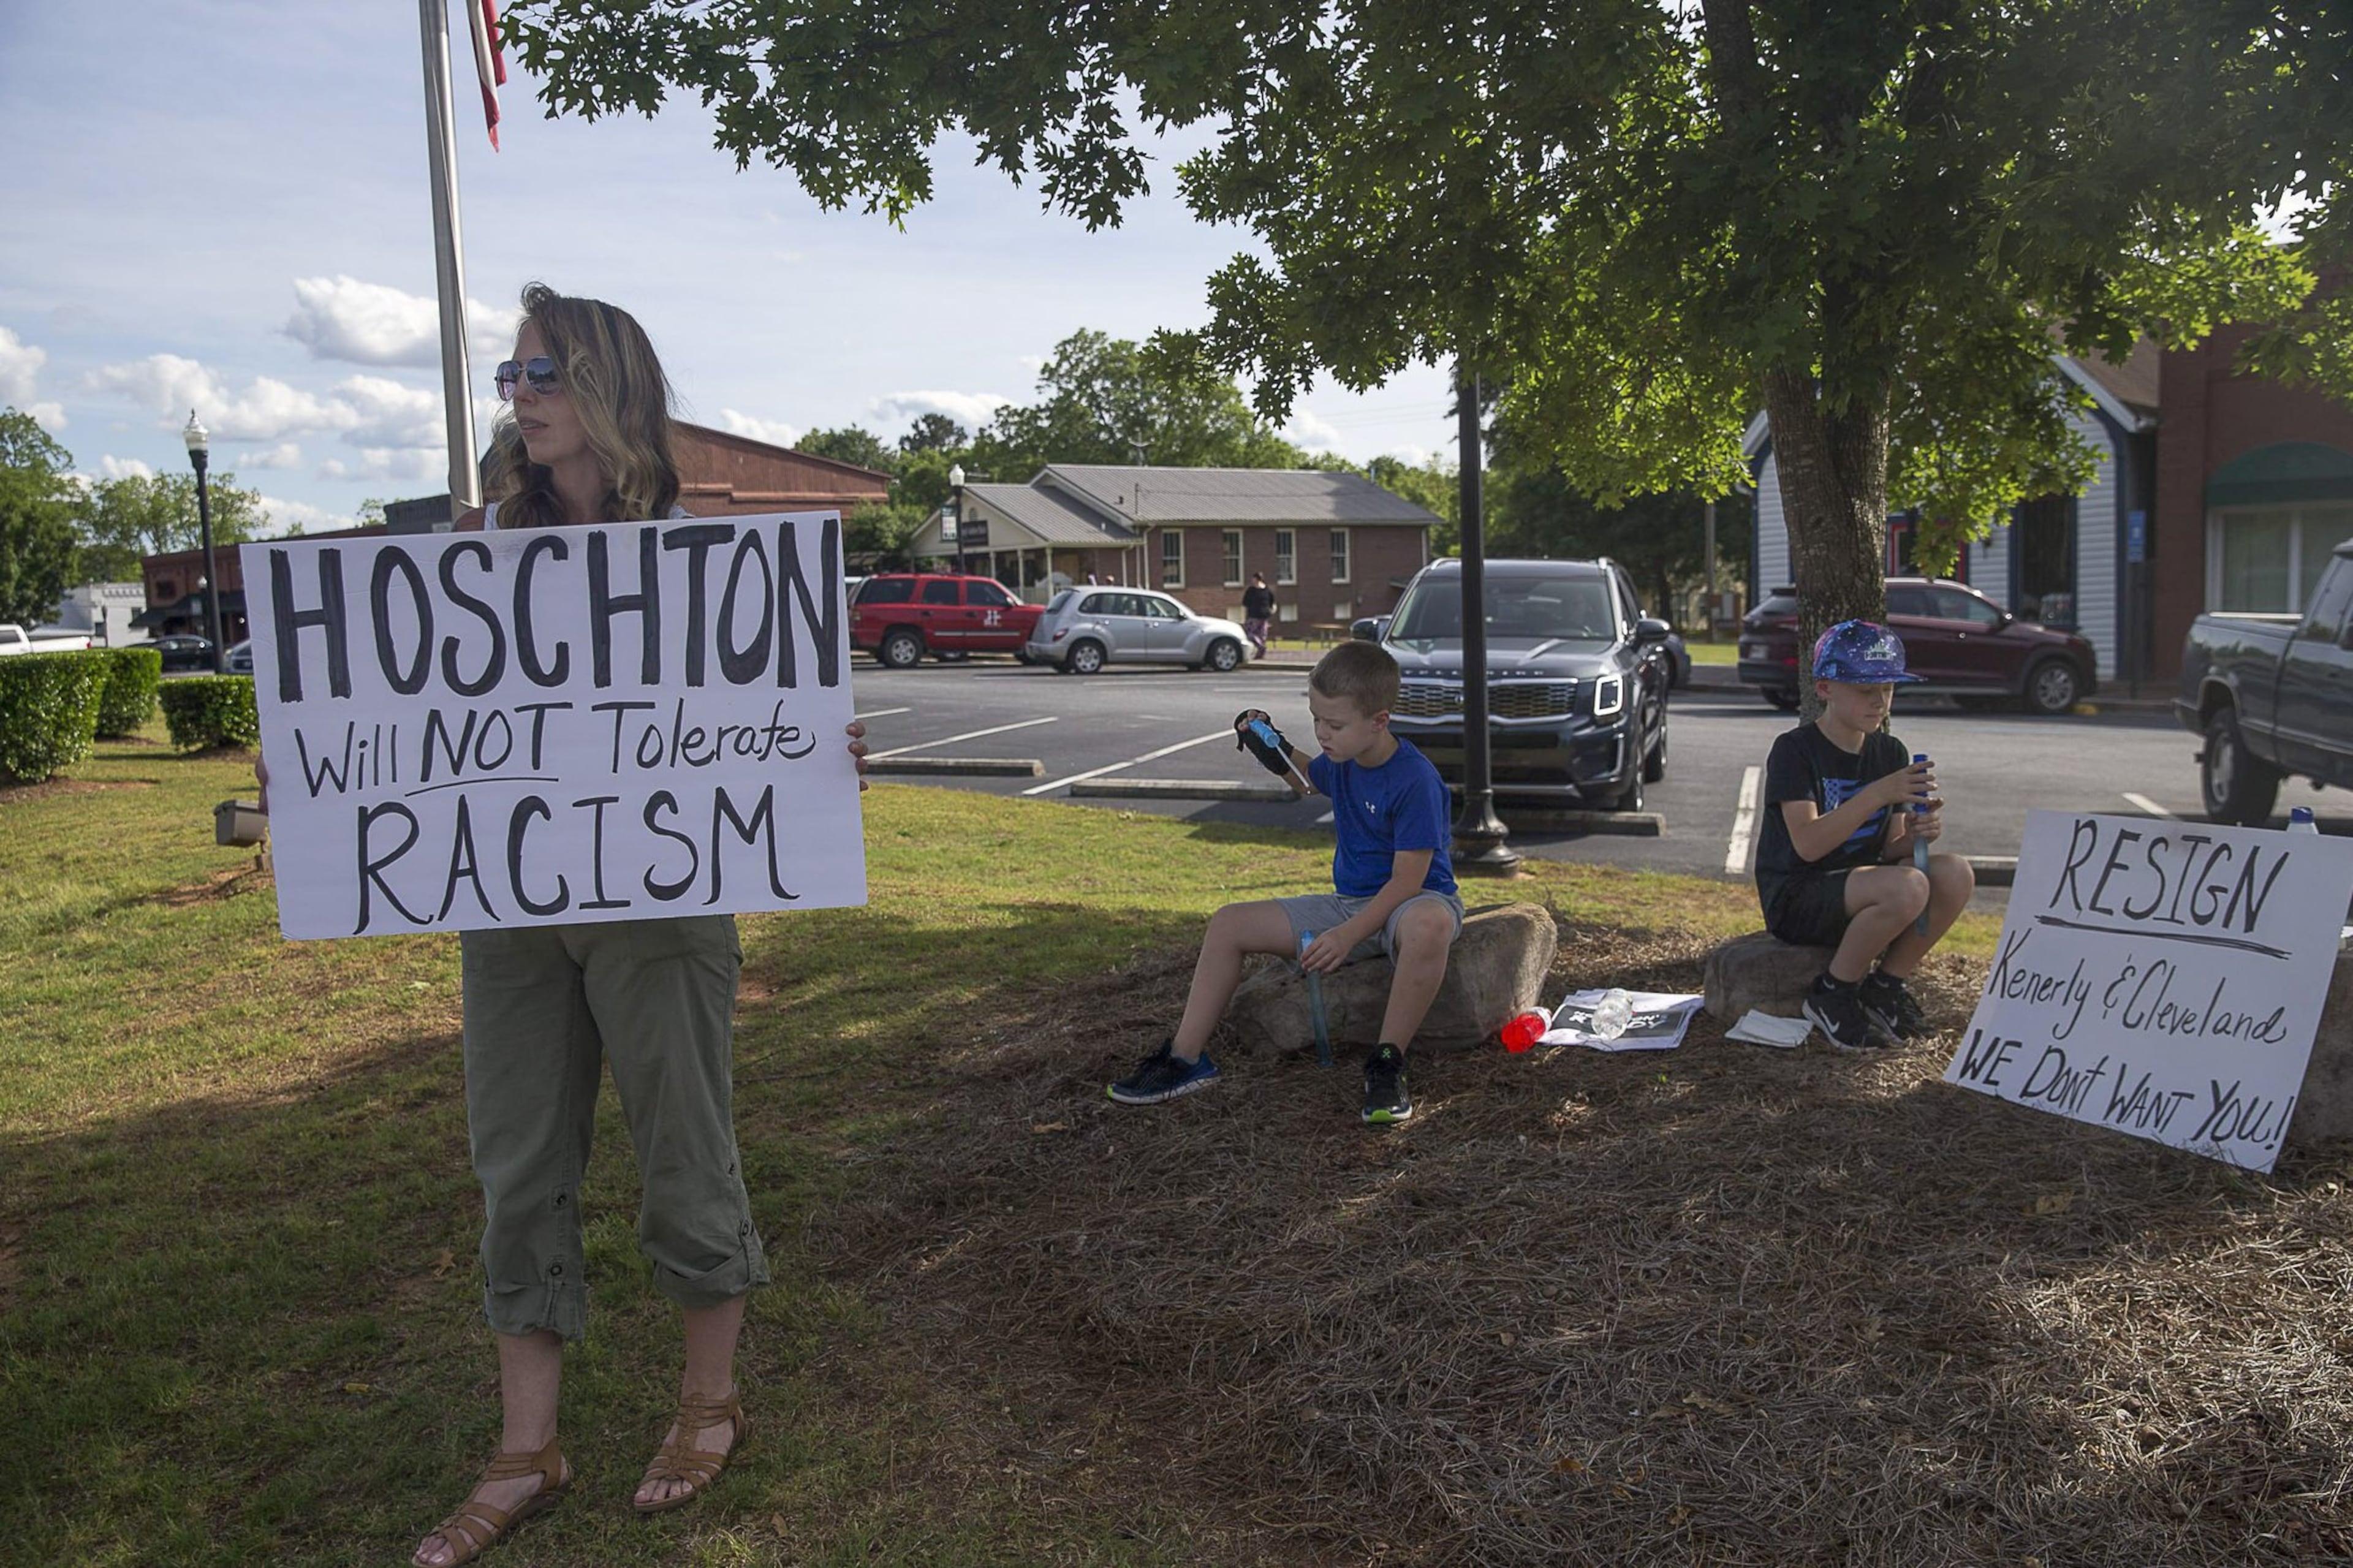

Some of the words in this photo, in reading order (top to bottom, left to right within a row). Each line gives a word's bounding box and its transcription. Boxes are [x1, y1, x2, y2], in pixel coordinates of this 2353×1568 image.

[270, 519, 839, 703] HOSCHTON
[295, 721, 397, 798] Will
[420, 702, 574, 783] NOT
[591, 697, 816, 775] Tolerate
[353, 784, 800, 935] RACISM
[2049, 819, 2289, 933] RESIGN
[1988, 927, 2091, 1040] Kenerly
[2122, 959, 2287, 1043] Cleveland
[1960, 1028, 2021, 1087] WE
[2104, 1062, 2195, 1134] WANT
